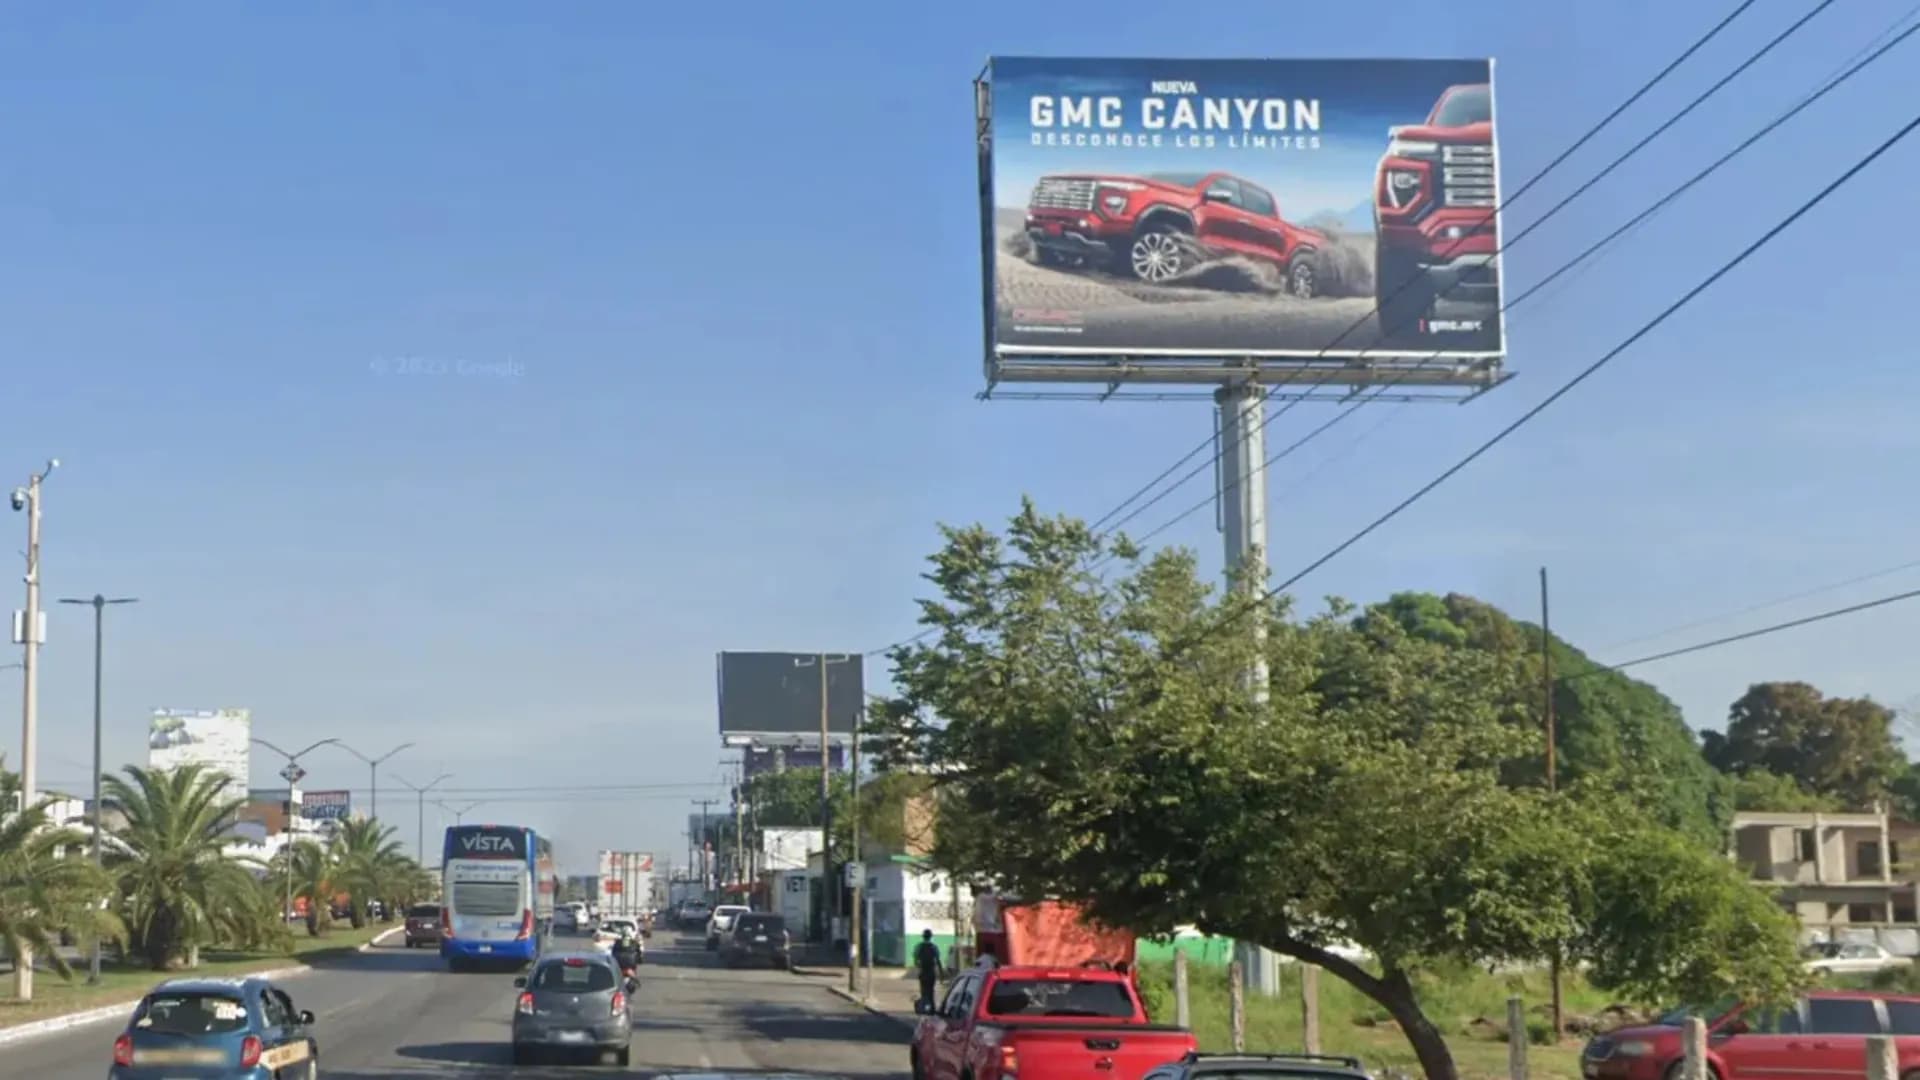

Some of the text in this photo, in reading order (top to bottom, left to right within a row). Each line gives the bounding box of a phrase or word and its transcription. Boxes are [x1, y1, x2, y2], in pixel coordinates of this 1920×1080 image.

[1151, 81, 1198, 94] NUEVA
[1030, 95, 1321, 131] GMC CANYON
[1031, 131, 1321, 150] DESCONOCE LOS LÍMITES
[461, 832, 515, 852] VISTA
